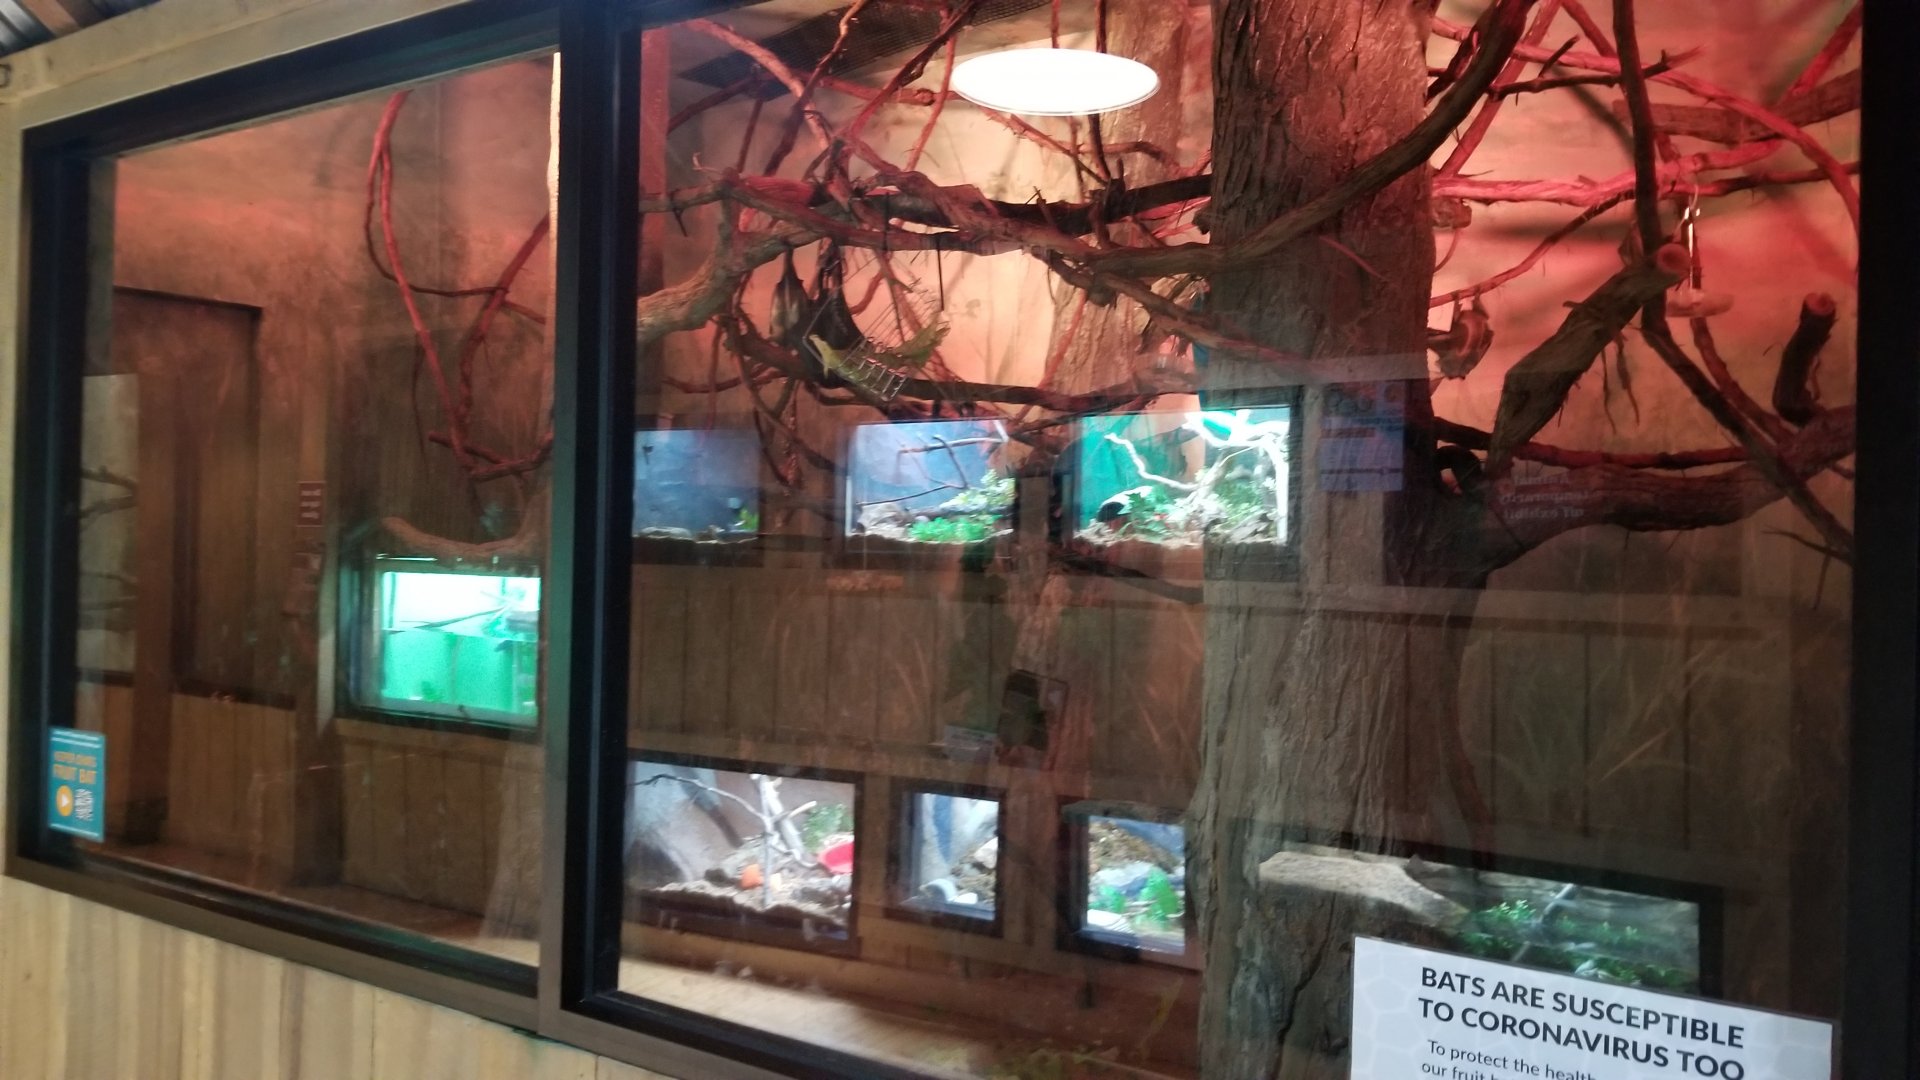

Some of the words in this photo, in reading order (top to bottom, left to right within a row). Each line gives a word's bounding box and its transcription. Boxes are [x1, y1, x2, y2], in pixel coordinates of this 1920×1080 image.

[1422, 967, 1485, 997] BATS
[1491, 981, 1544, 1009] ARE
[1552, 992, 1744, 1049] SUSCEPTIBLE
[1418, 997, 1454, 1022] TO
[1461, 1007, 1669, 1067] CORONAVIRUS
[1676, 1049, 1744, 1080] TOO
[1427, 1039, 1446, 1056] To
[1450, 1048, 1508, 1070] protect
[1513, 1058, 1540, 1076] the
[1421, 1063, 1447, 1077] our
